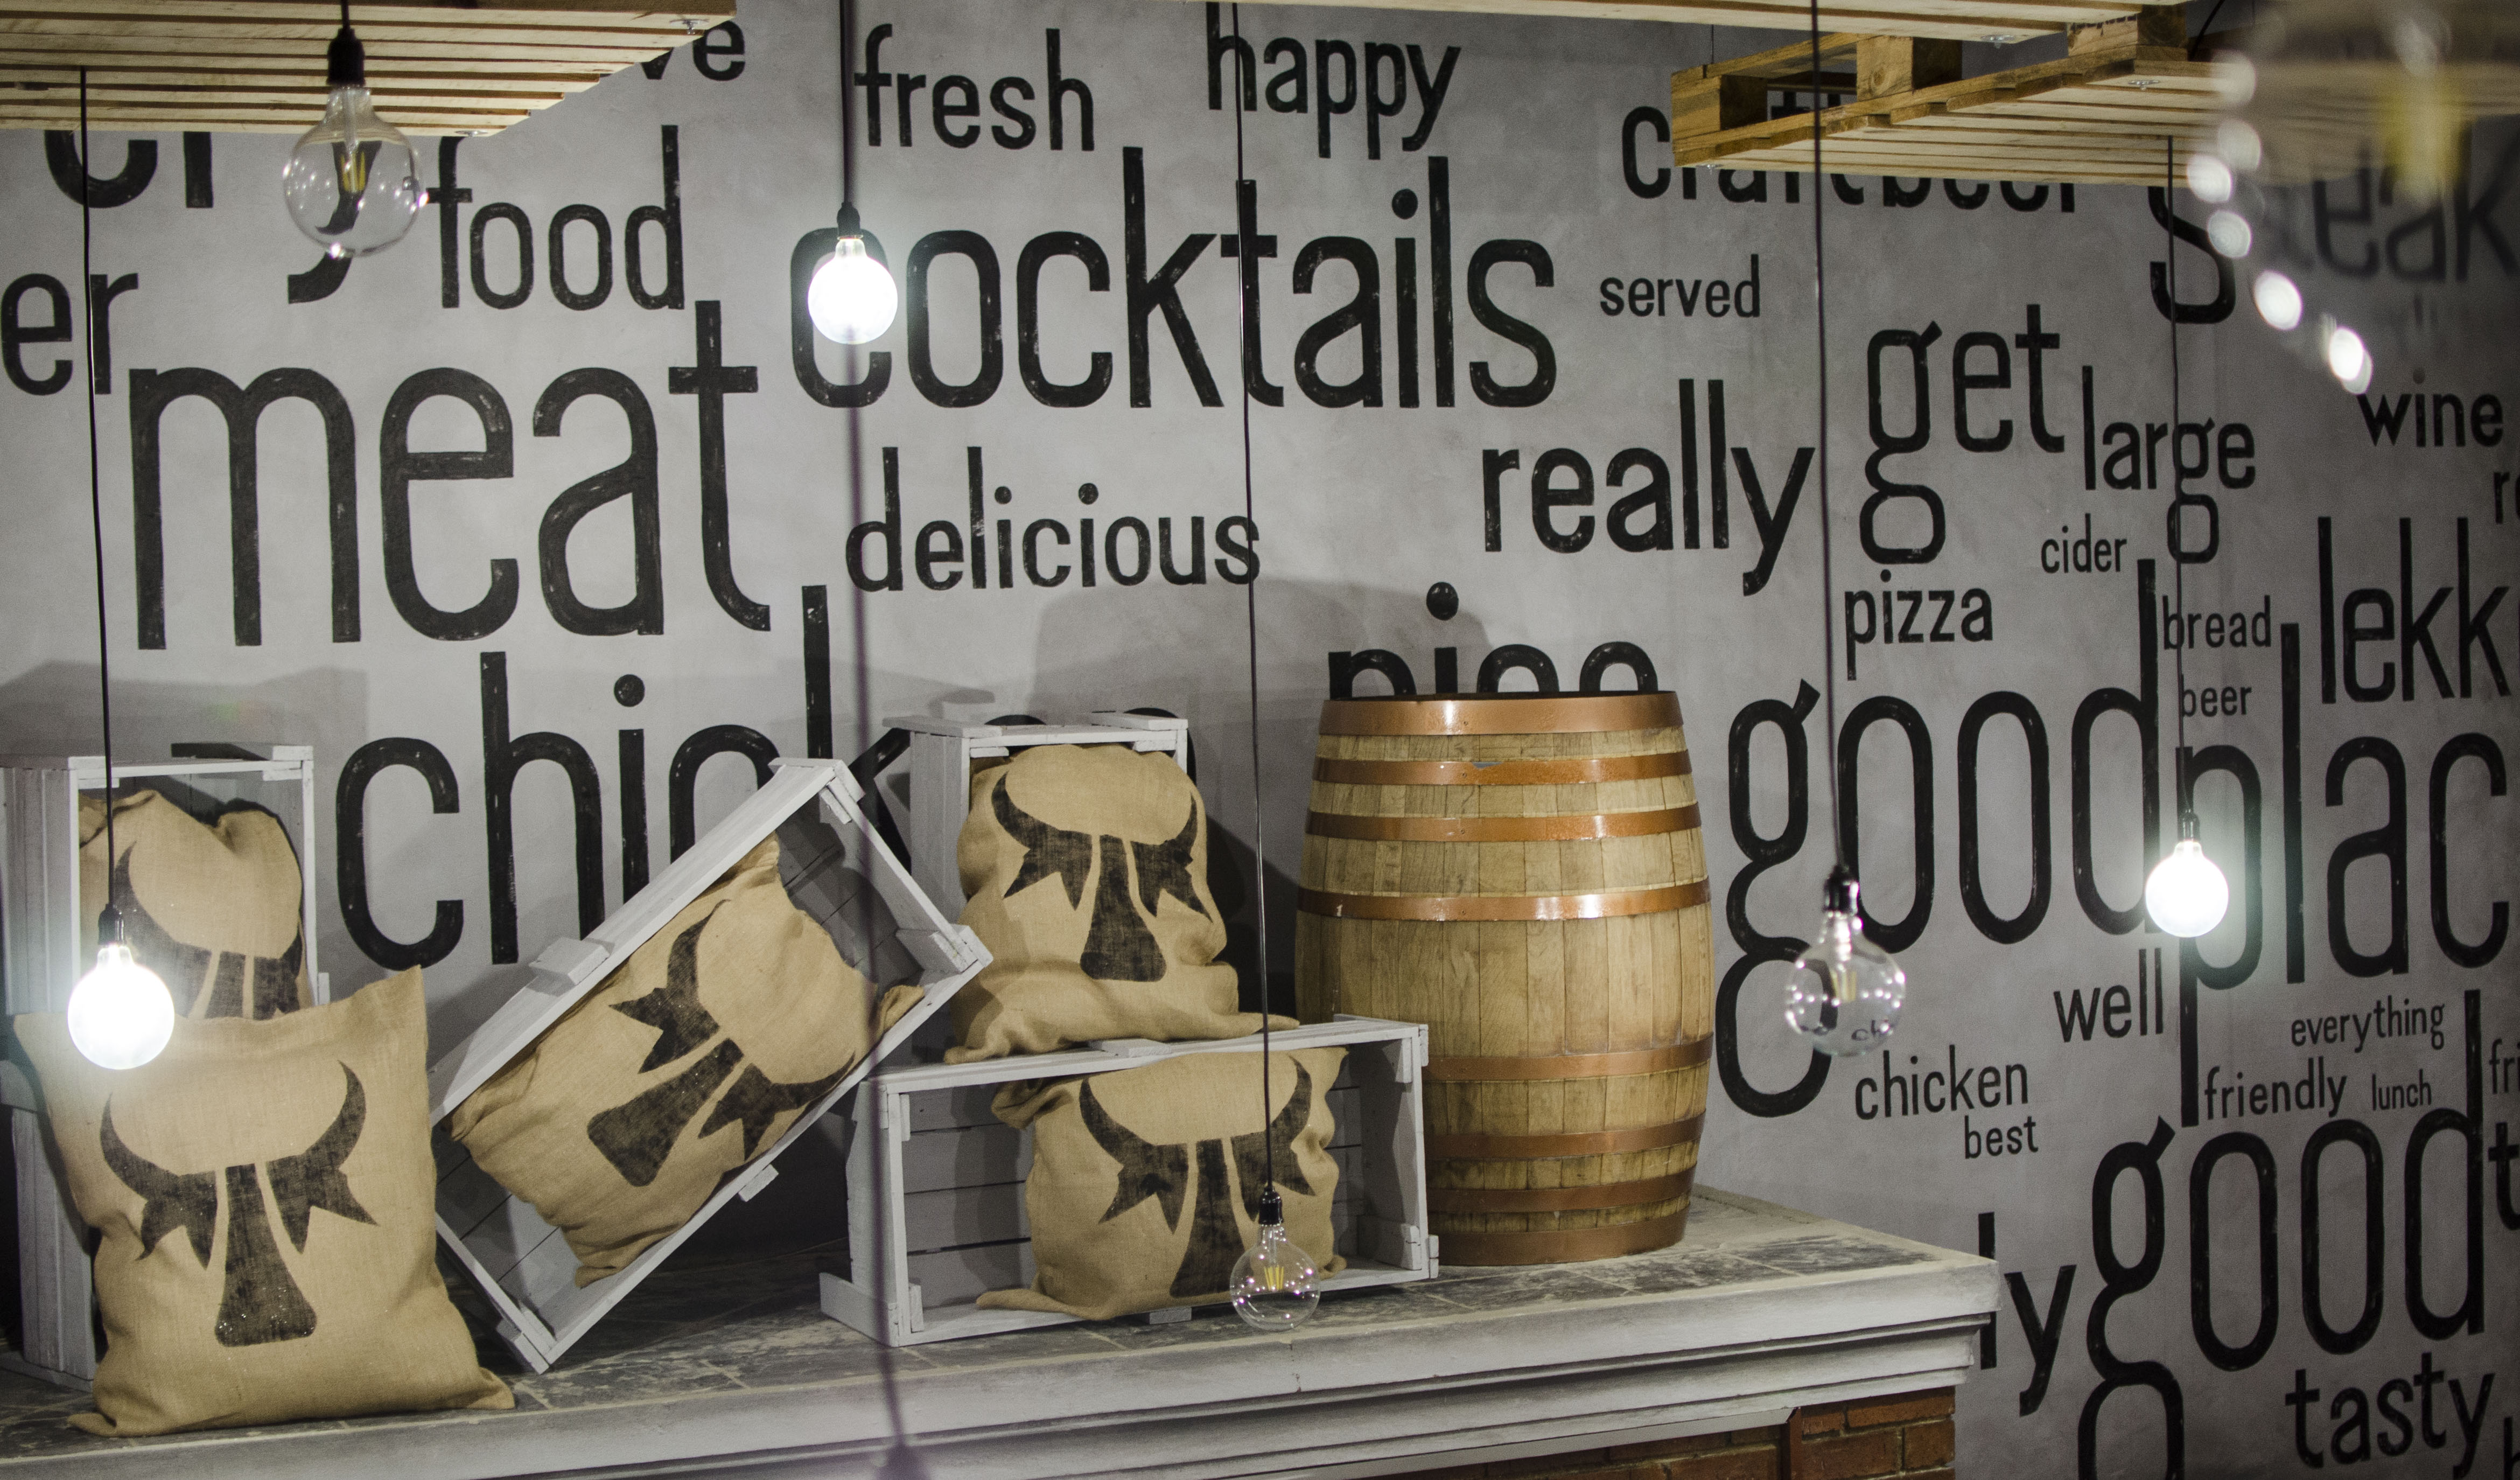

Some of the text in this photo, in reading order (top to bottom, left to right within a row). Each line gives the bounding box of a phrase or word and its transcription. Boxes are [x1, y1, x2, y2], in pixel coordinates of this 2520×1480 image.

[855, 24, 1095, 151] fresh
[1206, 2, 1461, 160] happy
[425, 124, 685, 309] food
[790, 146, 1558, 408] cocktails
[1599, 254, 1760, 318] served
[1859, 304, 2064, 564] get
[2082, 365, 2256, 564] large
[2356, 369, 2504, 448] wine
[129, 300, 771, 650] meat
[845, 446, 1261, 592] delicious
[1482, 379, 1816, 597] really
[2041, 513, 2127, 573] cider
[1845, 569, 1993, 681] pizza
[2162, 595, 2271, 650] bread
[2318, 515, 2520, 704] lekk
[2179, 674, 2252, 717] beer
[1715, 556, 2161, 1118] good
[2053, 947, 2164, 1043] well
[2290, 994, 2446, 1053] everything
[1855, 1044, 2029, 1120] chicken
[1965, 1115, 2039, 1159] best
[2204, 1055, 2348, 1121] friendly
[2371, 1069, 2433, 1111] lunch
[2077, 988, 2484, 1480] good
[2285, 1352, 2496, 1480] tasty
